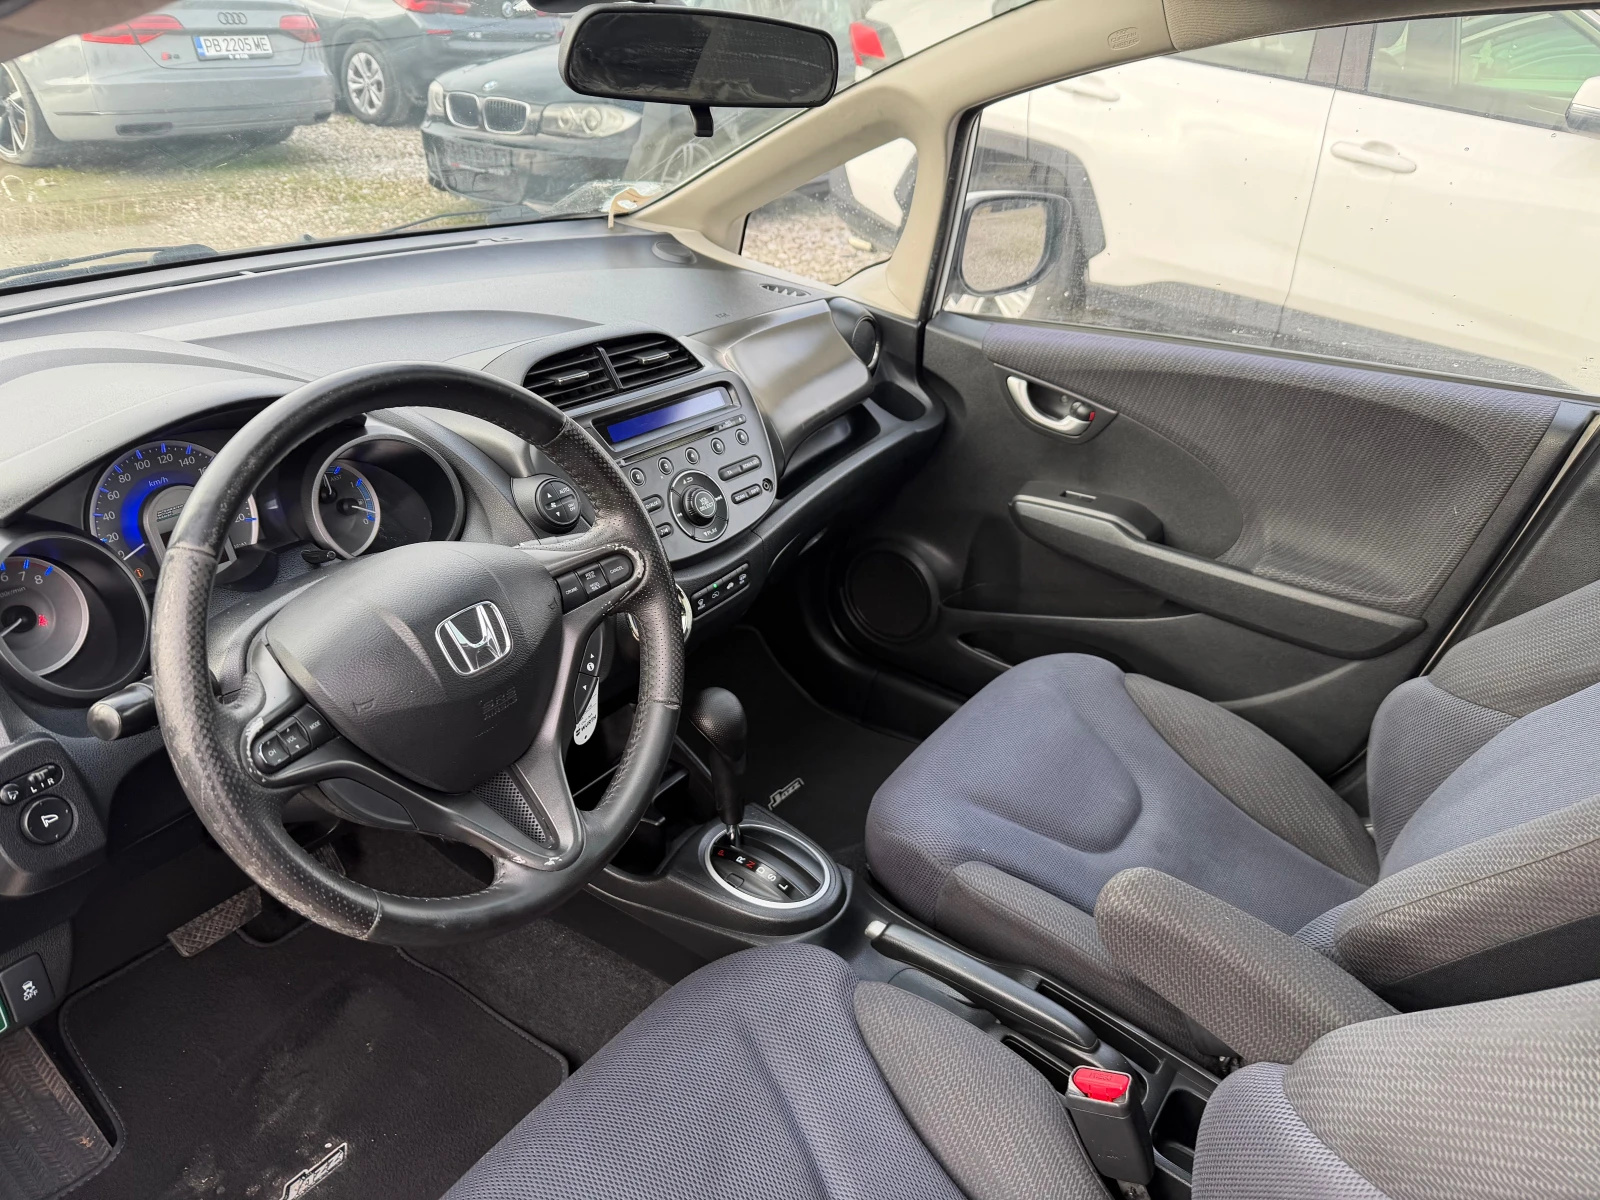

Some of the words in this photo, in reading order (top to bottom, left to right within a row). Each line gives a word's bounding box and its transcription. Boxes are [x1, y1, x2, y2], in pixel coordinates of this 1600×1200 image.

[203, 38, 222, 53] PB
[222, 37, 252, 52] 2205
[252, 37, 270, 52] ME
[157, 453, 174, 465] 120
[179, 456, 196, 468] 140
[134, 459, 151, 471] 100
[118, 473, 132, 484] 80
[148, 476, 169, 488] km/h
[107, 490, 120, 501] 60
[560, 486, 571, 495] AUTO
[102, 511, 116, 521] 40
[107, 532, 119, 543] 20
[609, 565, 625, 575] CANCEL
[0, 572, 9, 582] 6
[18, 571, 26, 581] 7
[34, 574, 44, 585] 8
[46, 777, 55, 786] R
[736, 855, 746, 864] R
[746, 860, 756, 869] N
[756, 866, 765, 875] D
[767, 873, 777, 882] S
[778, 882, 788, 891] L
